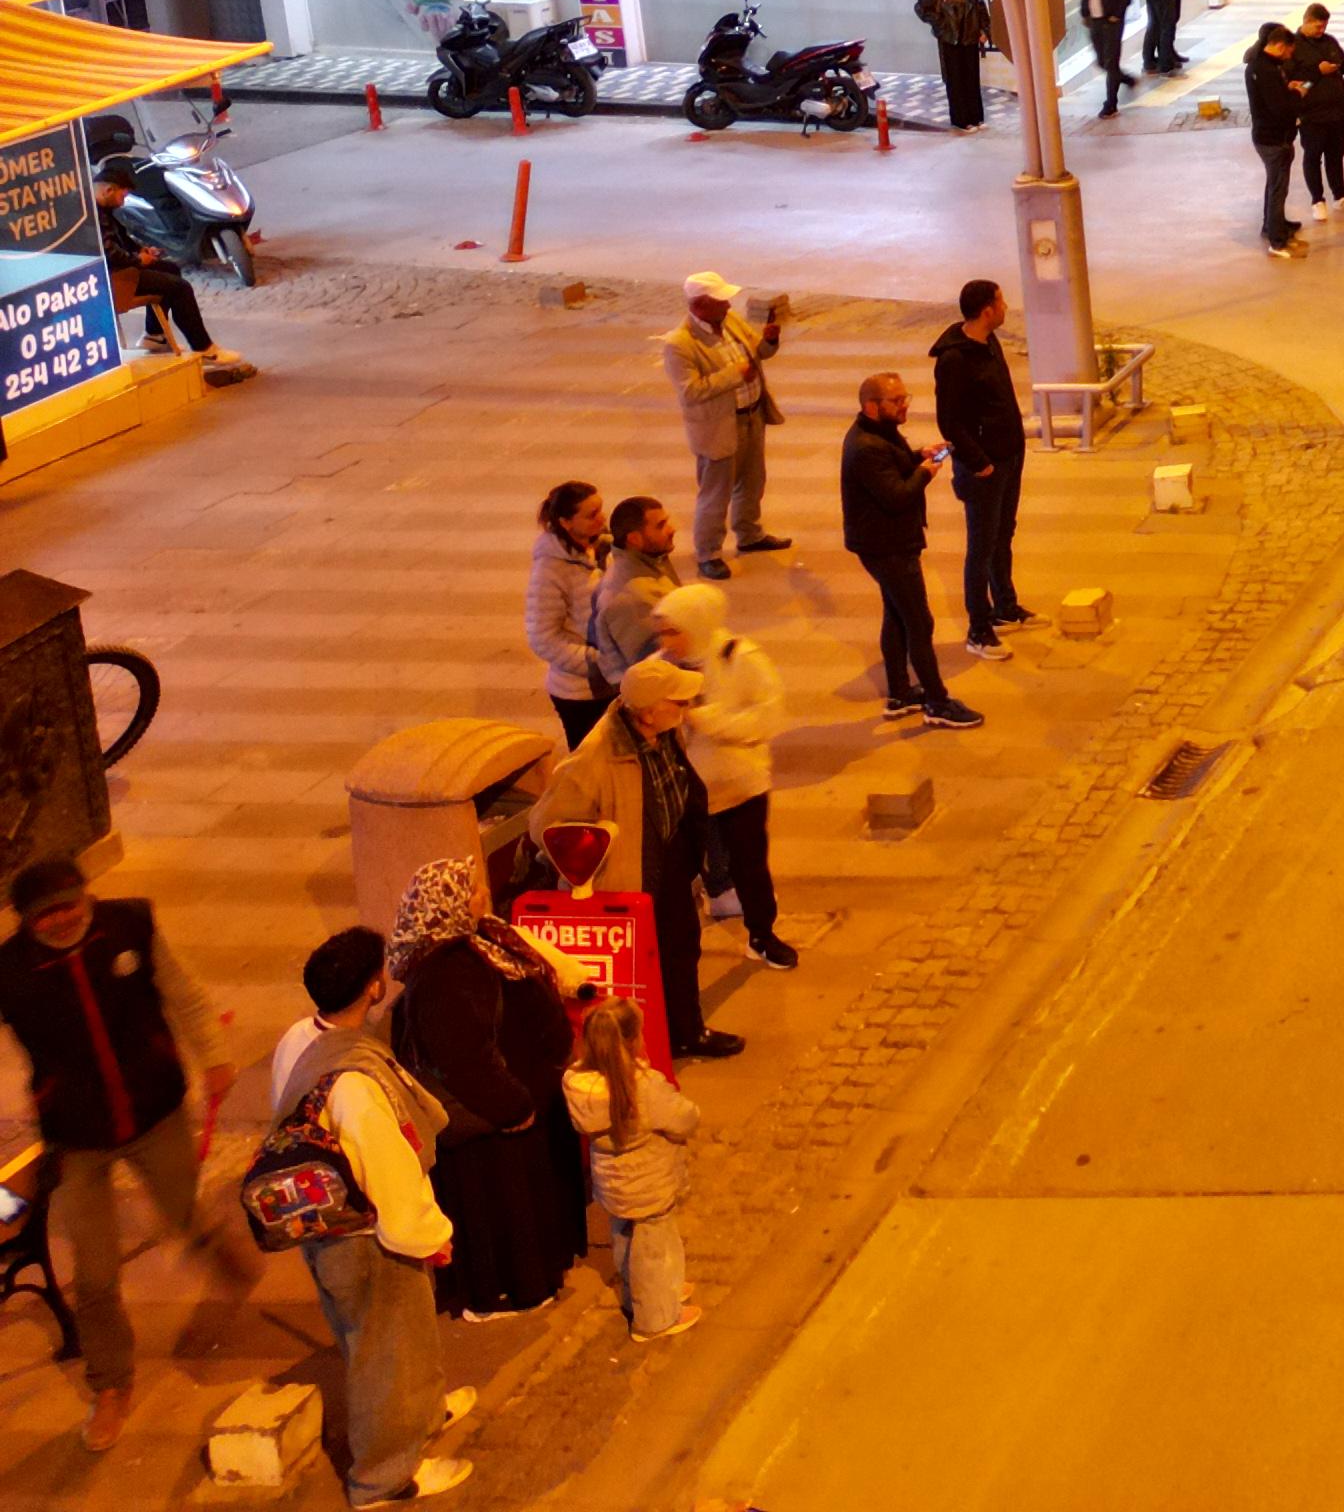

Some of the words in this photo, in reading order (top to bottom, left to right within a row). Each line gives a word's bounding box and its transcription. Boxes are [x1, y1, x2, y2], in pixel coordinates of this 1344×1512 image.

[9, 203, 57, 241] YERİ
[36, 274, 99, 319] Paket
[20, 333, 37, 360] 0
[42, 314, 85, 352] 544
[5, 363, 49, 401] 254
[53, 348, 82, 378] 42
[86, 337, 108, 367] 31
[521, 919, 633, 954] NÖBETÇİ
